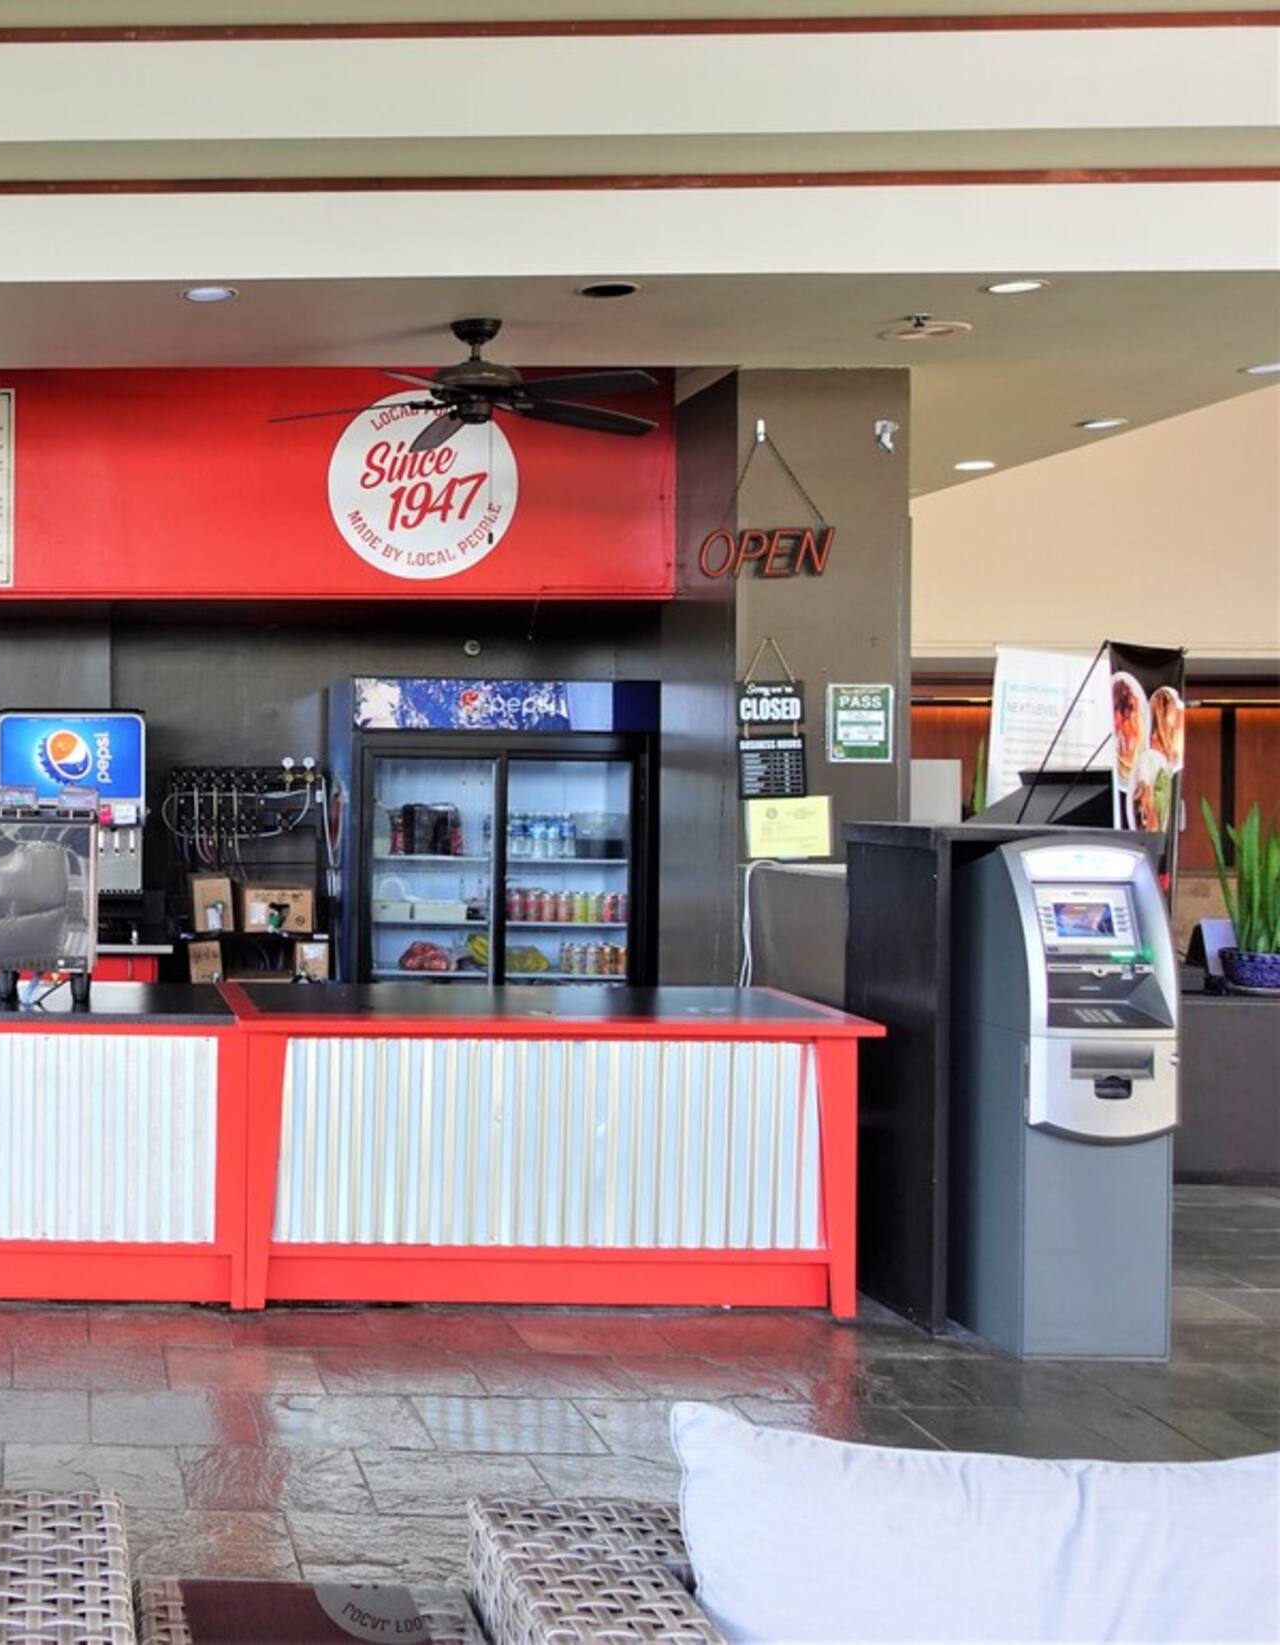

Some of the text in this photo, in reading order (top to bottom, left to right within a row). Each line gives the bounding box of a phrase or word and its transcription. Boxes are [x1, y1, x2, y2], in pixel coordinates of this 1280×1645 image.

[359, 441, 458, 489] Since
[388, 472, 487, 531] 1947
[347, 502, 502, 566] MADE BY LOCAL PEOPLE
[699, 527, 835, 578] OPEN
[740, 697, 801, 720] CLOSED
[839, 695, 882, 709] PASS
[94, 731, 113, 784] pepsi
